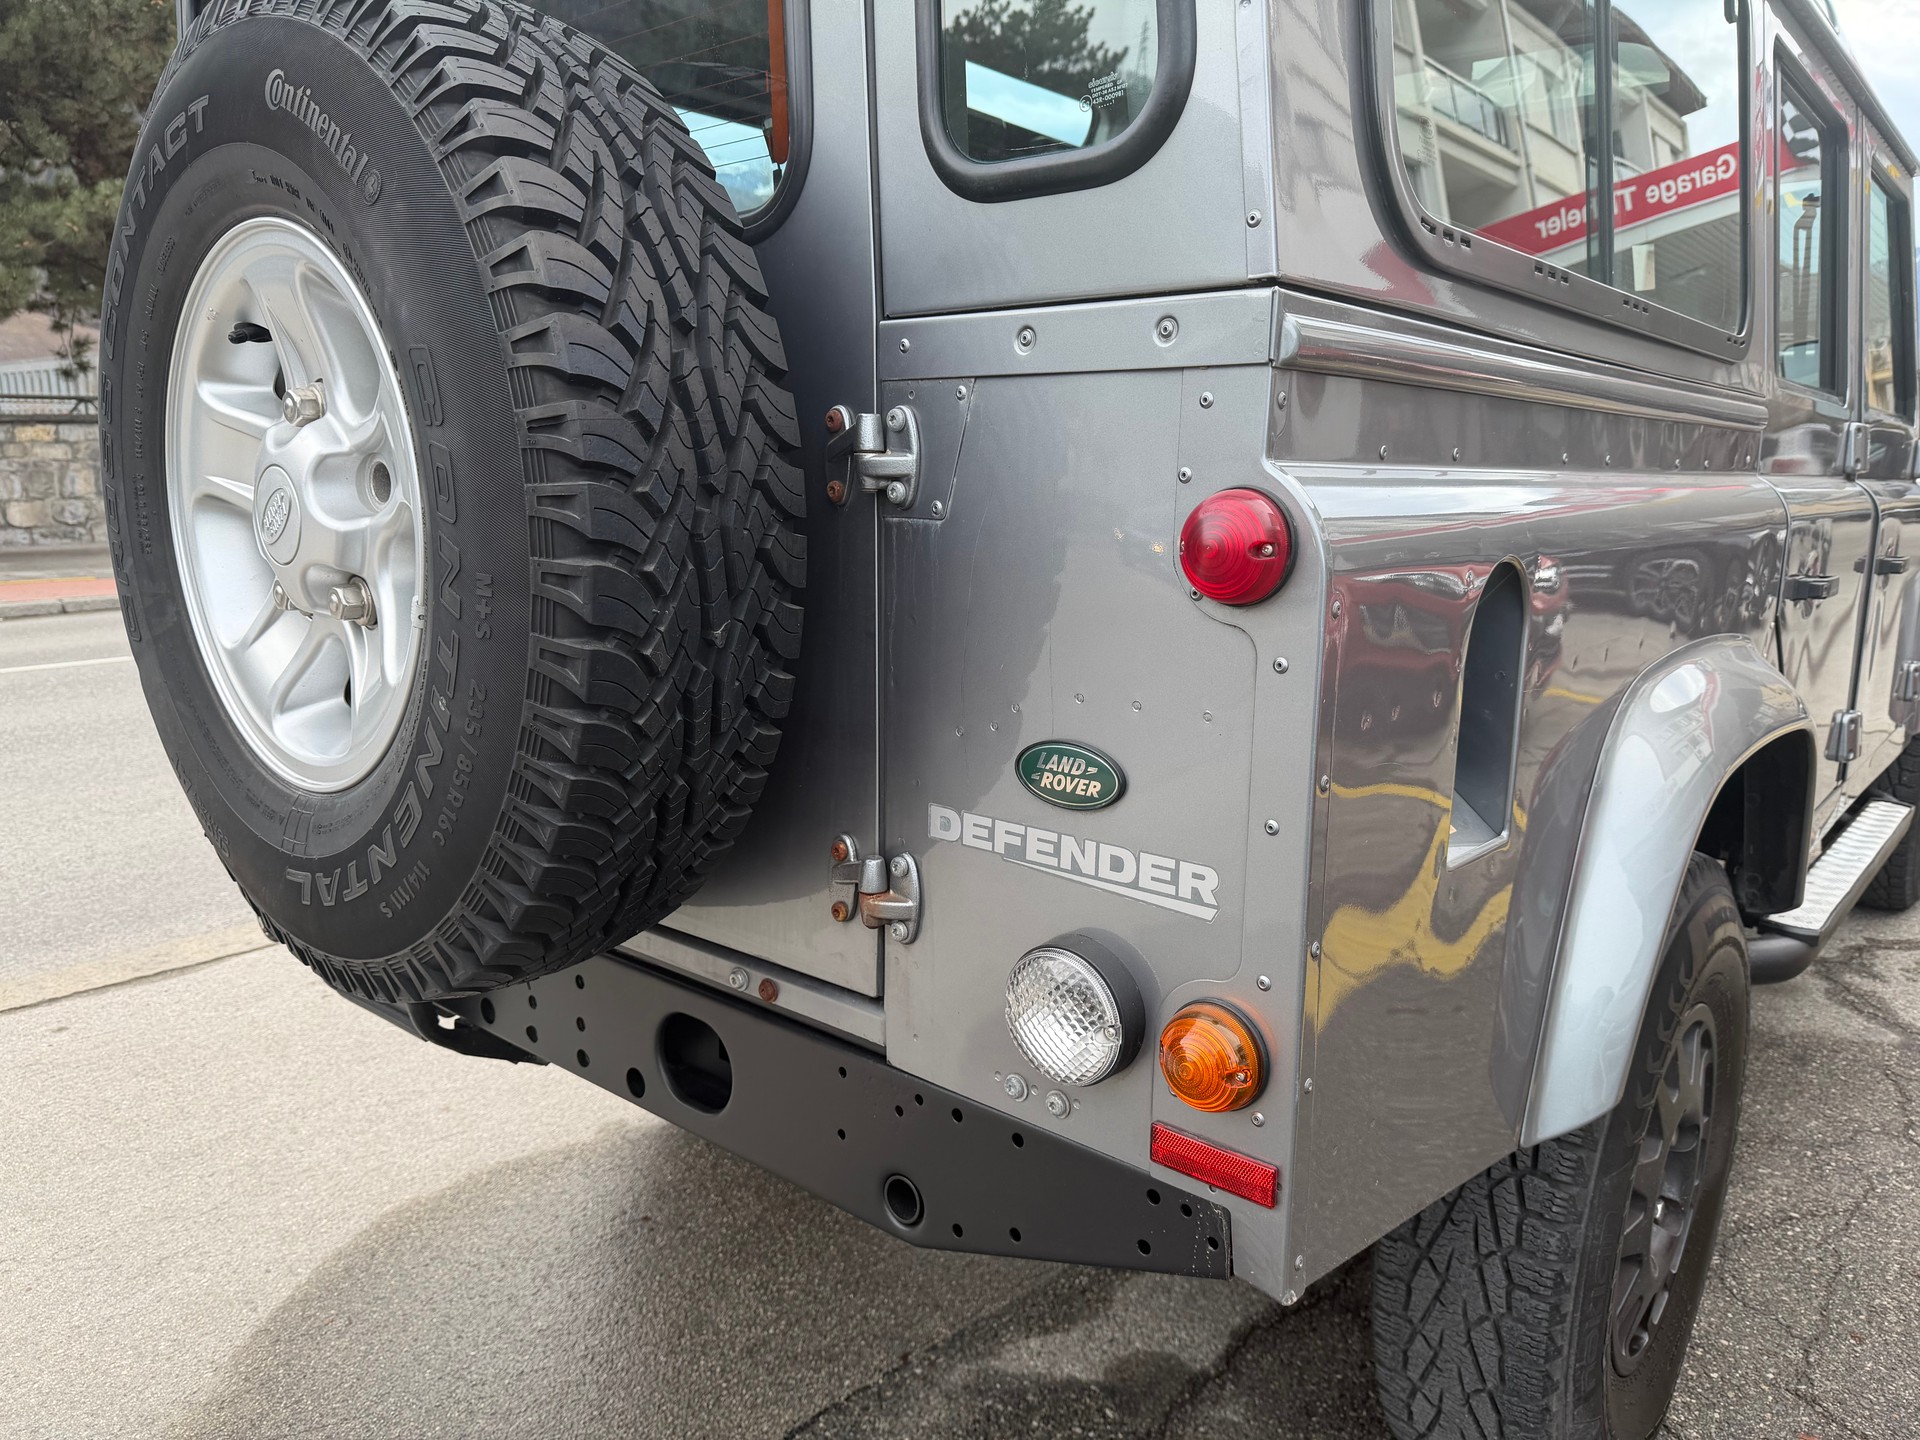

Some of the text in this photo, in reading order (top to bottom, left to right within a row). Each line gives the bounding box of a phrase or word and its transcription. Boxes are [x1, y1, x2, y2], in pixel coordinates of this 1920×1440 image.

[264, 68, 369, 185] Continental
[103, 94, 209, 360] CONTACT
[285, 345, 462, 906] CONTINENTAL
[475, 572, 493, 641] M+S
[1037, 752, 1087, 775] LAND
[1040, 771, 1101, 799] ROVER
[929, 805, 1220, 906] DEFENDER
